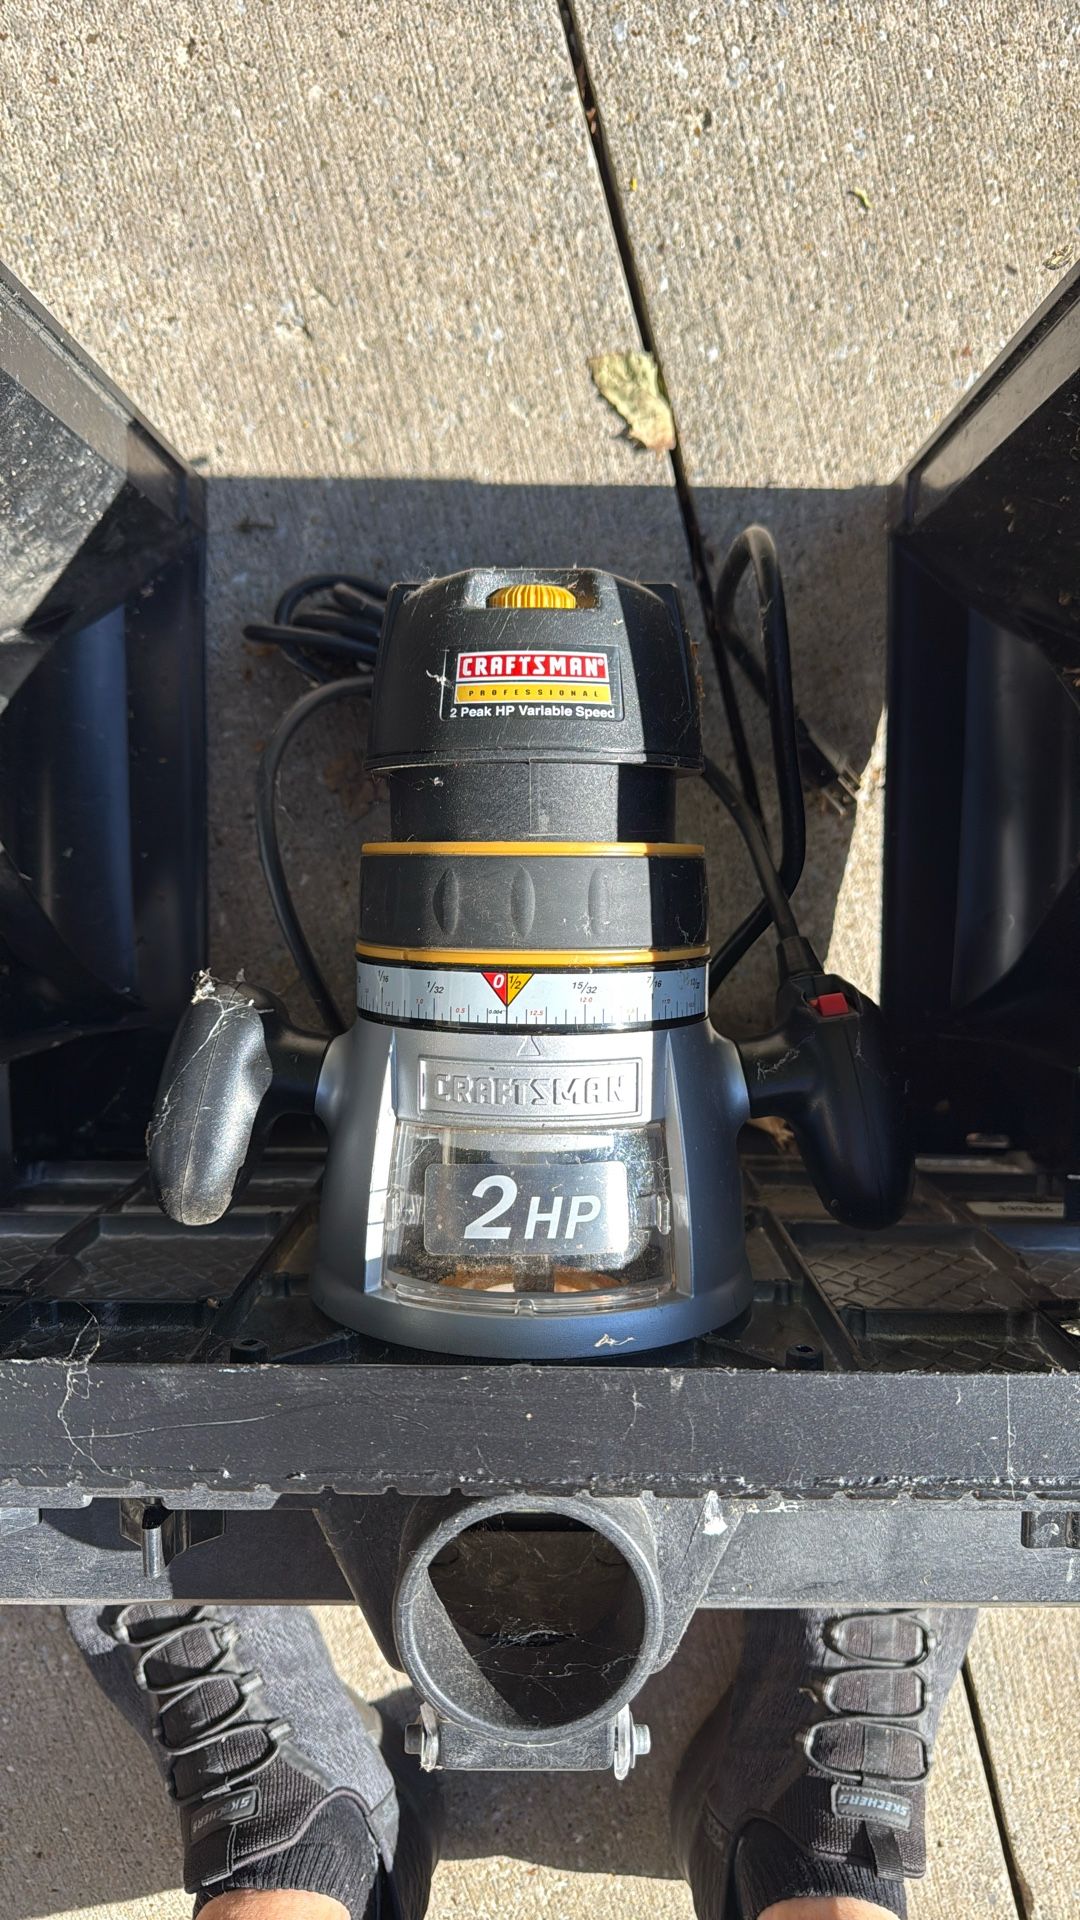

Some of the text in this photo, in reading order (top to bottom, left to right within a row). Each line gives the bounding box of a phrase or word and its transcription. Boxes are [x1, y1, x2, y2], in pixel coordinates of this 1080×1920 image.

[468, 688, 599, 698] PROFESSIONAL
[450, 704, 615, 720] 2 Peak HP Variable Speed
[426, 981, 445, 994] 1/32
[492, 973, 505, 989] 0
[509, 975, 522, 990] 1/2
[572, 981, 598, 994] 15/32
[434, 1073, 625, 1106] CRAFTSMAN
[463, 1174, 601, 1240] 2 HP
